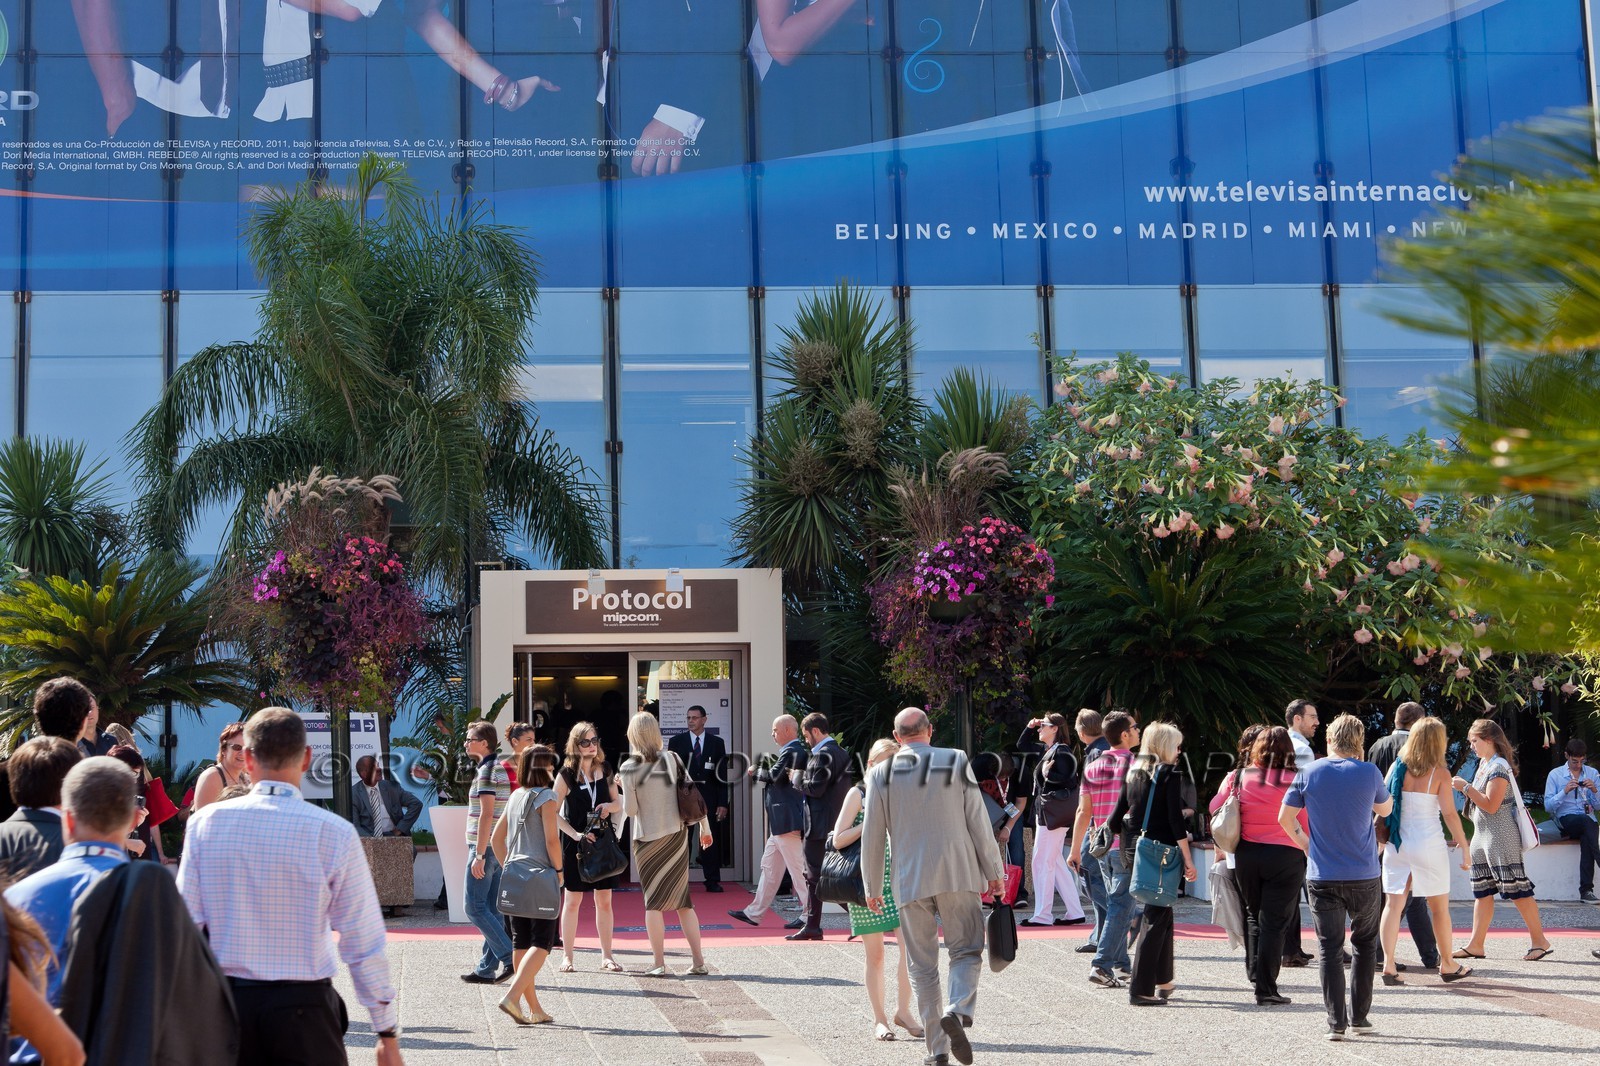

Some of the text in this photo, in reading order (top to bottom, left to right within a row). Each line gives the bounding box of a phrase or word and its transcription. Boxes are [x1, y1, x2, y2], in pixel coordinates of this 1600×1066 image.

[0, 91, 40, 110] D
[84, 140, 150, 148] Co-Producción
[153, 140, 164, 148] de
[167, 140, 210, 148] TELEVISA
[214, 142, 218, 150] y
[221, 140, 264, 149] RECORD,
[294, 140, 312, 149] bajo
[450, 141, 454, 149] y
[458, 139, 482, 147] Radio
[494, 138, 532, 146] Televisão
[535, 138, 568, 147] Record,
[571, 138, 588, 146] S.A.
[630, 138, 662, 147] Original
[4, 151, 20, 159] Dori
[24, 151, 50, 159] Media
[54, 151, 109, 160] International,
[113, 151, 144, 159] GMBH.
[201, 151, 212, 159] All
[214, 151, 239, 161] rights
[242, 151, 278, 159] reserved
[299, 151, 360, 160] co-production
[402, 150, 445, 158] TELEVISA
[448, 150, 464, 158] and
[467, 150, 509, 158] RECORD,
[539, 149, 563, 157] under
[566, 149, 595, 157] license
[599, 149, 608, 158] by
[2, 162, 35, 171] Record,
[38, 162, 56, 170] S.A.
[59, 162, 92, 172] Original
[126, 162, 136, 171] by
[195, 162, 224, 171] Group,
[228, 161, 245, 169] S.A.
[248, 161, 264, 169] and
[267, 161, 284, 169] Dori
[288, 161, 314, 169] Media
[836, 223, 951, 240] BEIJING
[992, 222, 1098, 239] MEXICO
[1139, 222, 1248, 239] MADRID
[1289, 221, 1372, 238] MIAMI
[573, 585, 691, 610] Protocol
